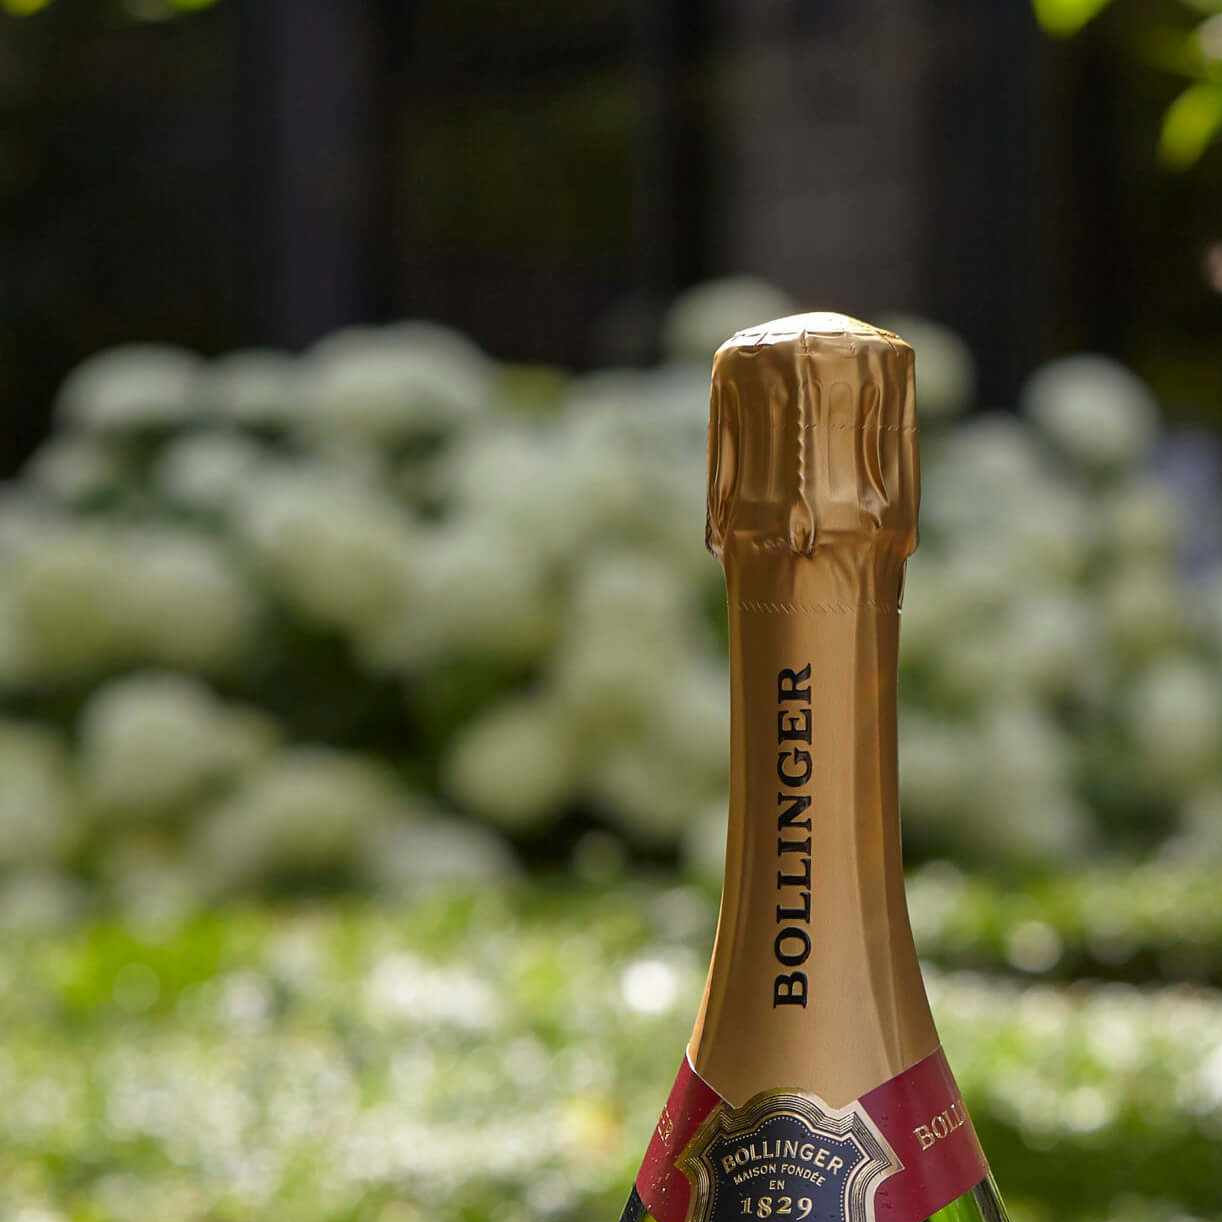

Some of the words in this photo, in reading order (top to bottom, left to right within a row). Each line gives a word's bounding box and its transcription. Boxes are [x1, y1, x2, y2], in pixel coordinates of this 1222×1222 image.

[772, 662, 813, 1009] BOLLINGER
[720, 1139, 844, 1176] BOLLINGER
[733, 1163, 777, 1185] MAISON
[781, 1163, 826, 1187] FONDÉE
[768, 1180, 785, 1191] EN
[740, 1196, 813, 1221] 1829
